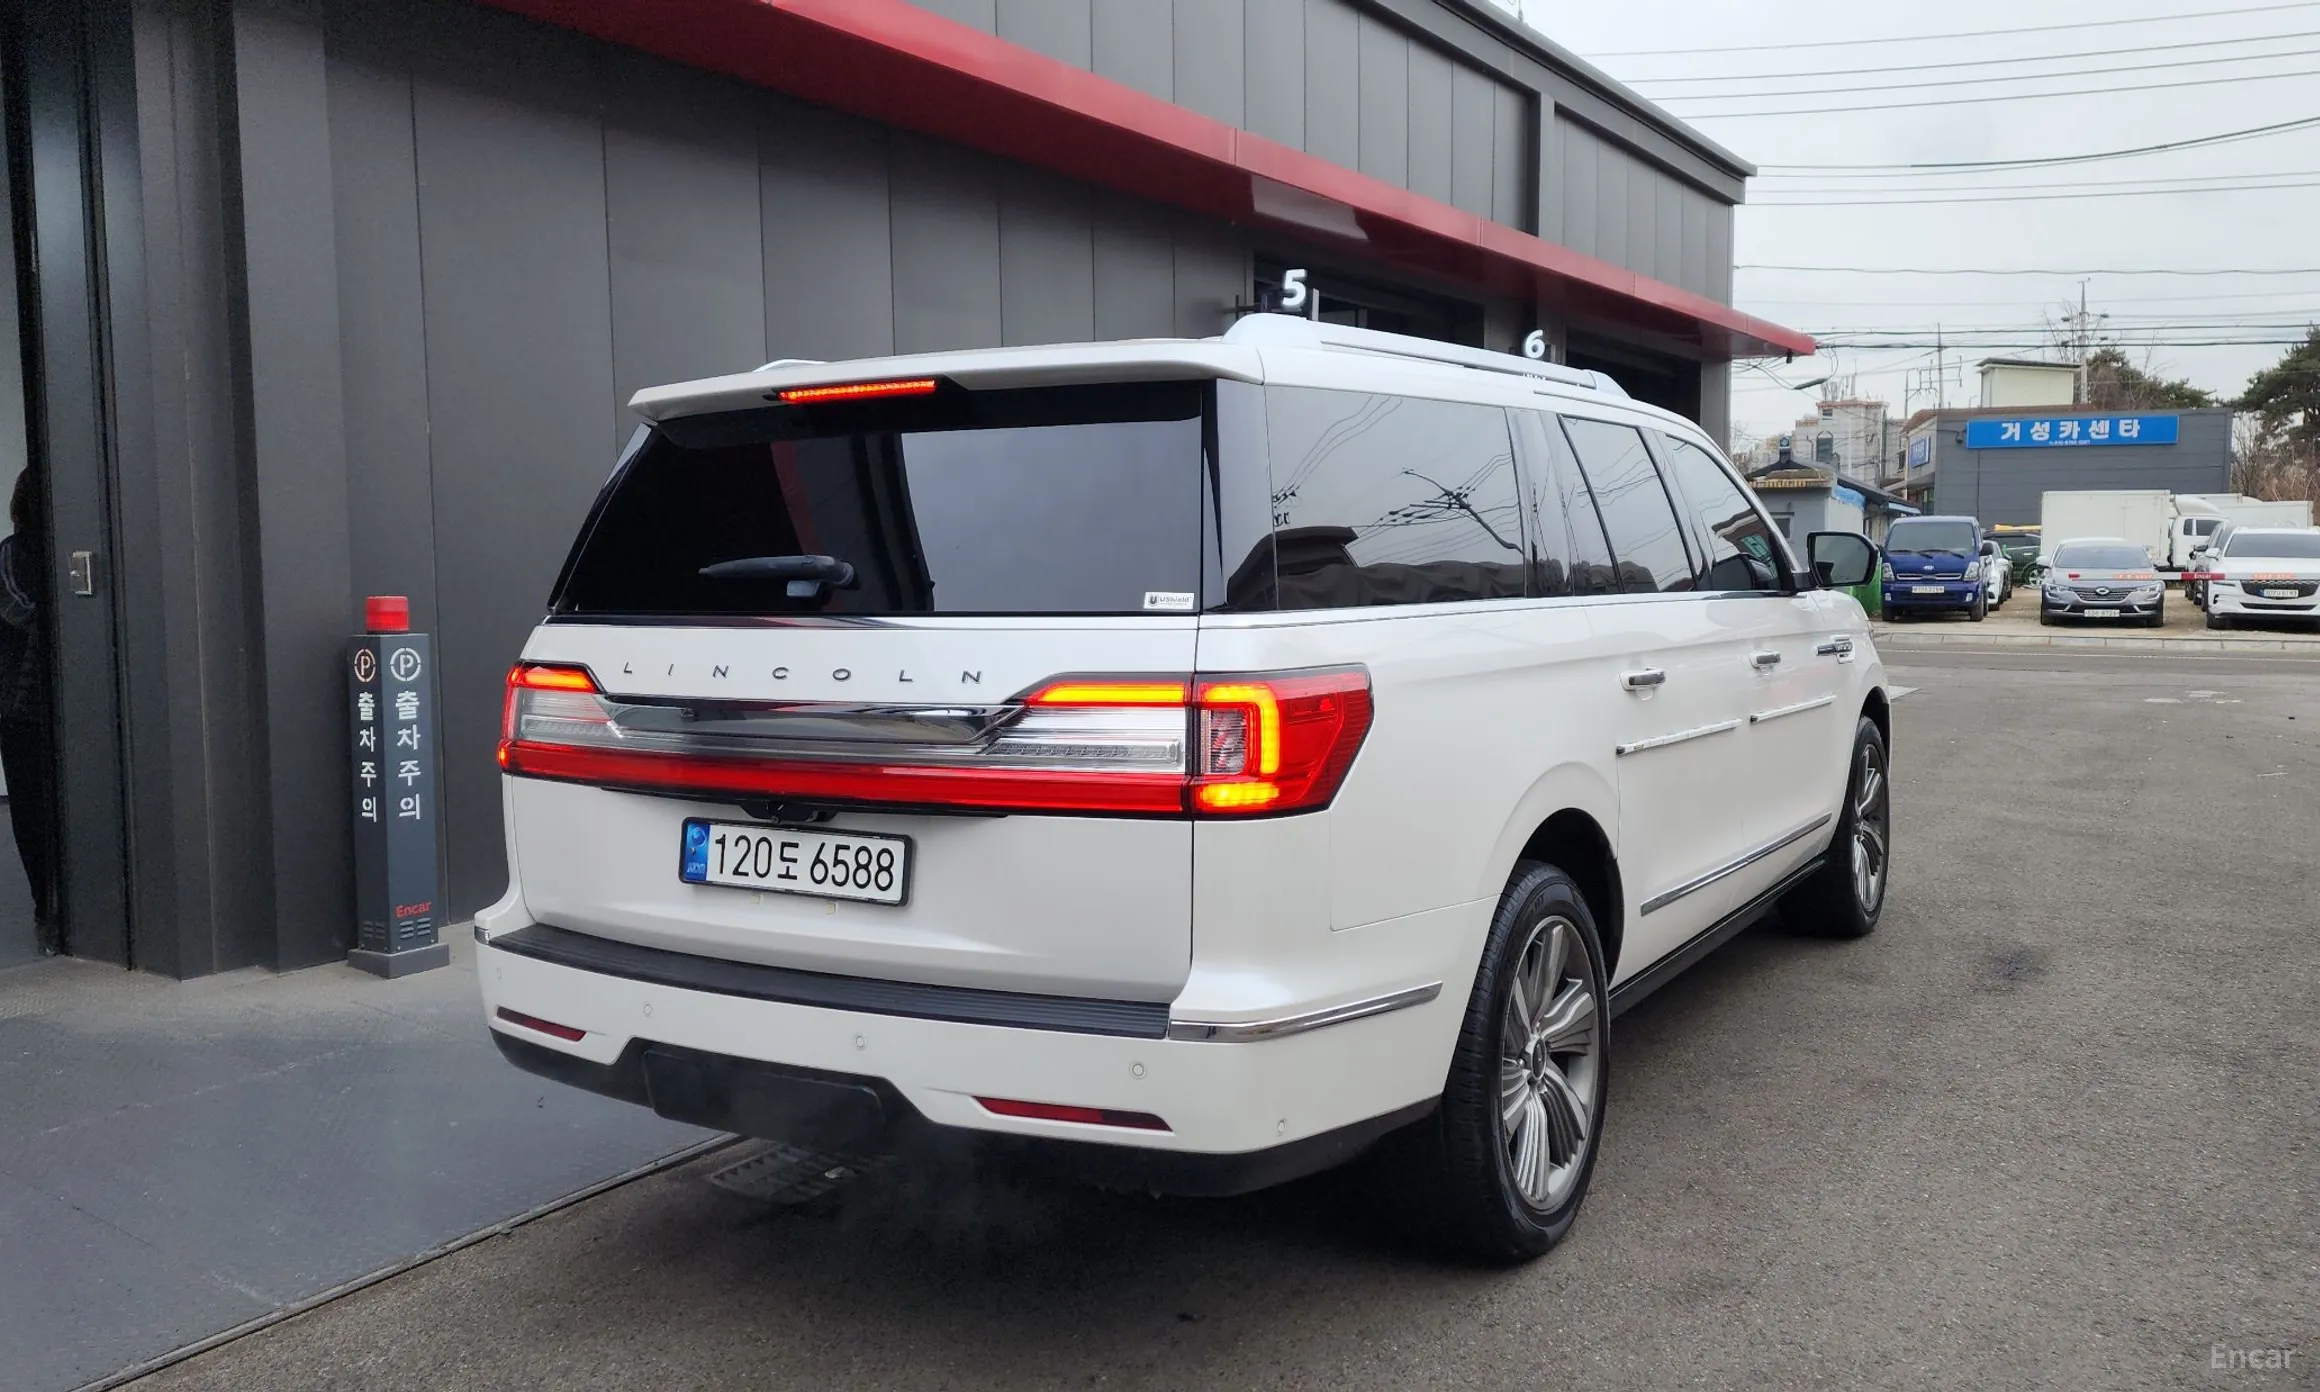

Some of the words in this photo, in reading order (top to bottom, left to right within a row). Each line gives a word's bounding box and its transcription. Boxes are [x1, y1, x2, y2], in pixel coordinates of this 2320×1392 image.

[1281, 268, 1308, 307] 5
[1523, 329, 1546, 359] 6
[2001, 419, 2141, 441] 거성카센타
[623, 661, 982, 684] LINCOLN
[358, 692, 377, 822] 출차주의
[395, 691, 421, 820] 출차주의
[714, 833, 800, 880] 120도
[810, 842, 895, 891] 6588
[395, 901, 432, 918] Encar
